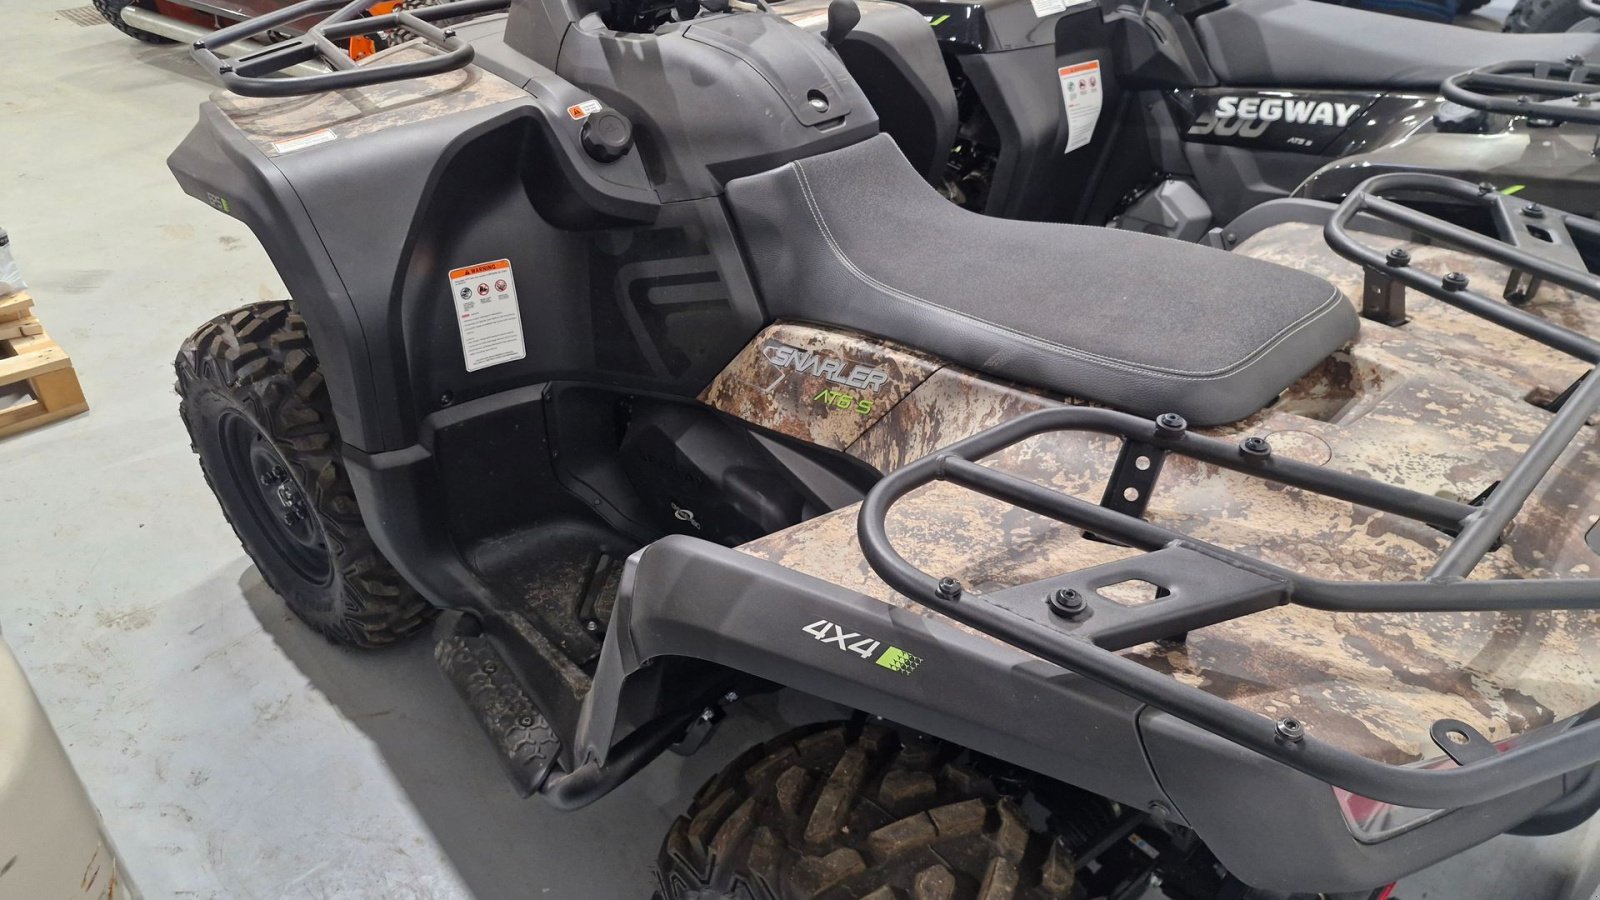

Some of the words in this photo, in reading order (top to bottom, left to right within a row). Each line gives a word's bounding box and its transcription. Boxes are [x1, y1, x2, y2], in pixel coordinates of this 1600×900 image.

[1215, 97, 1360, 127] SEGWAY
[471, 264, 496, 275] WARNING
[769, 346, 888, 393] SNARLER
[813, 389, 854, 409] AT6
[856, 399, 874, 415] S
[801, 619, 881, 659] 4X4
